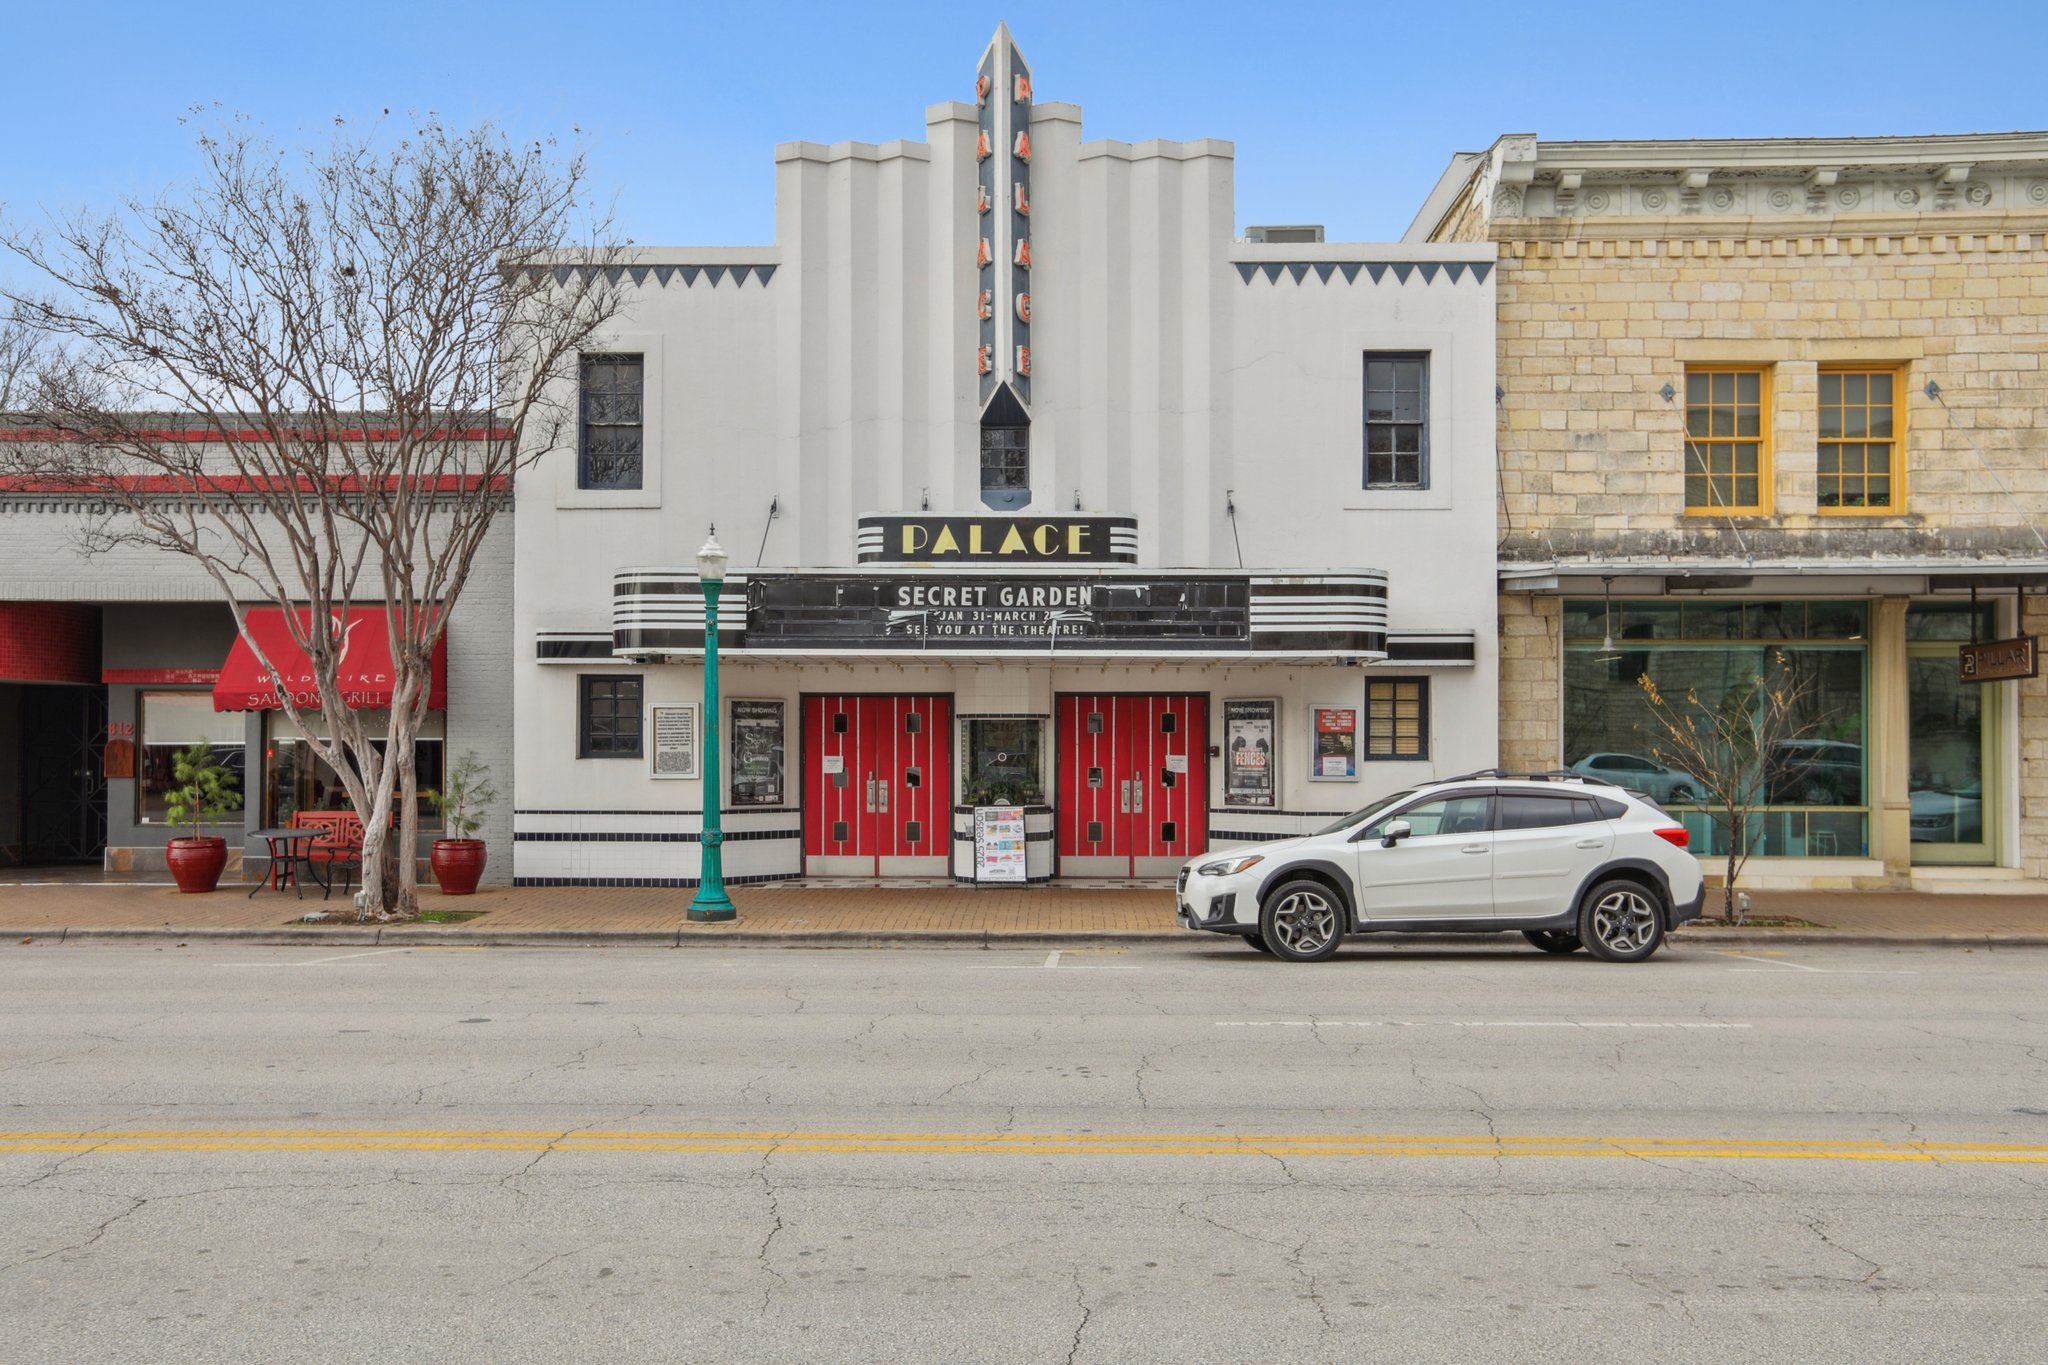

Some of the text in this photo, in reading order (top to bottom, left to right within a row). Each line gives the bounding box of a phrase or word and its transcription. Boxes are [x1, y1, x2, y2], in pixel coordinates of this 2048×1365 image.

[976, 75, 992, 375] PALACE
[1013, 74, 1032, 376] PALACE
[902, 523, 1092, 556] PALACE
[898, 586, 1092, 606] SECRET GARDEN
[939, 611, 963, 621] JAN
[972, 611, 1036, 621] 31-MARCH
[906, 625, 1084, 635] SEE YOU AT THE THEATRE!
[108, 722, 134, 736] 812
[1235, 751, 1266, 766] FENCES
[976, 808, 985, 868] 2025 season
